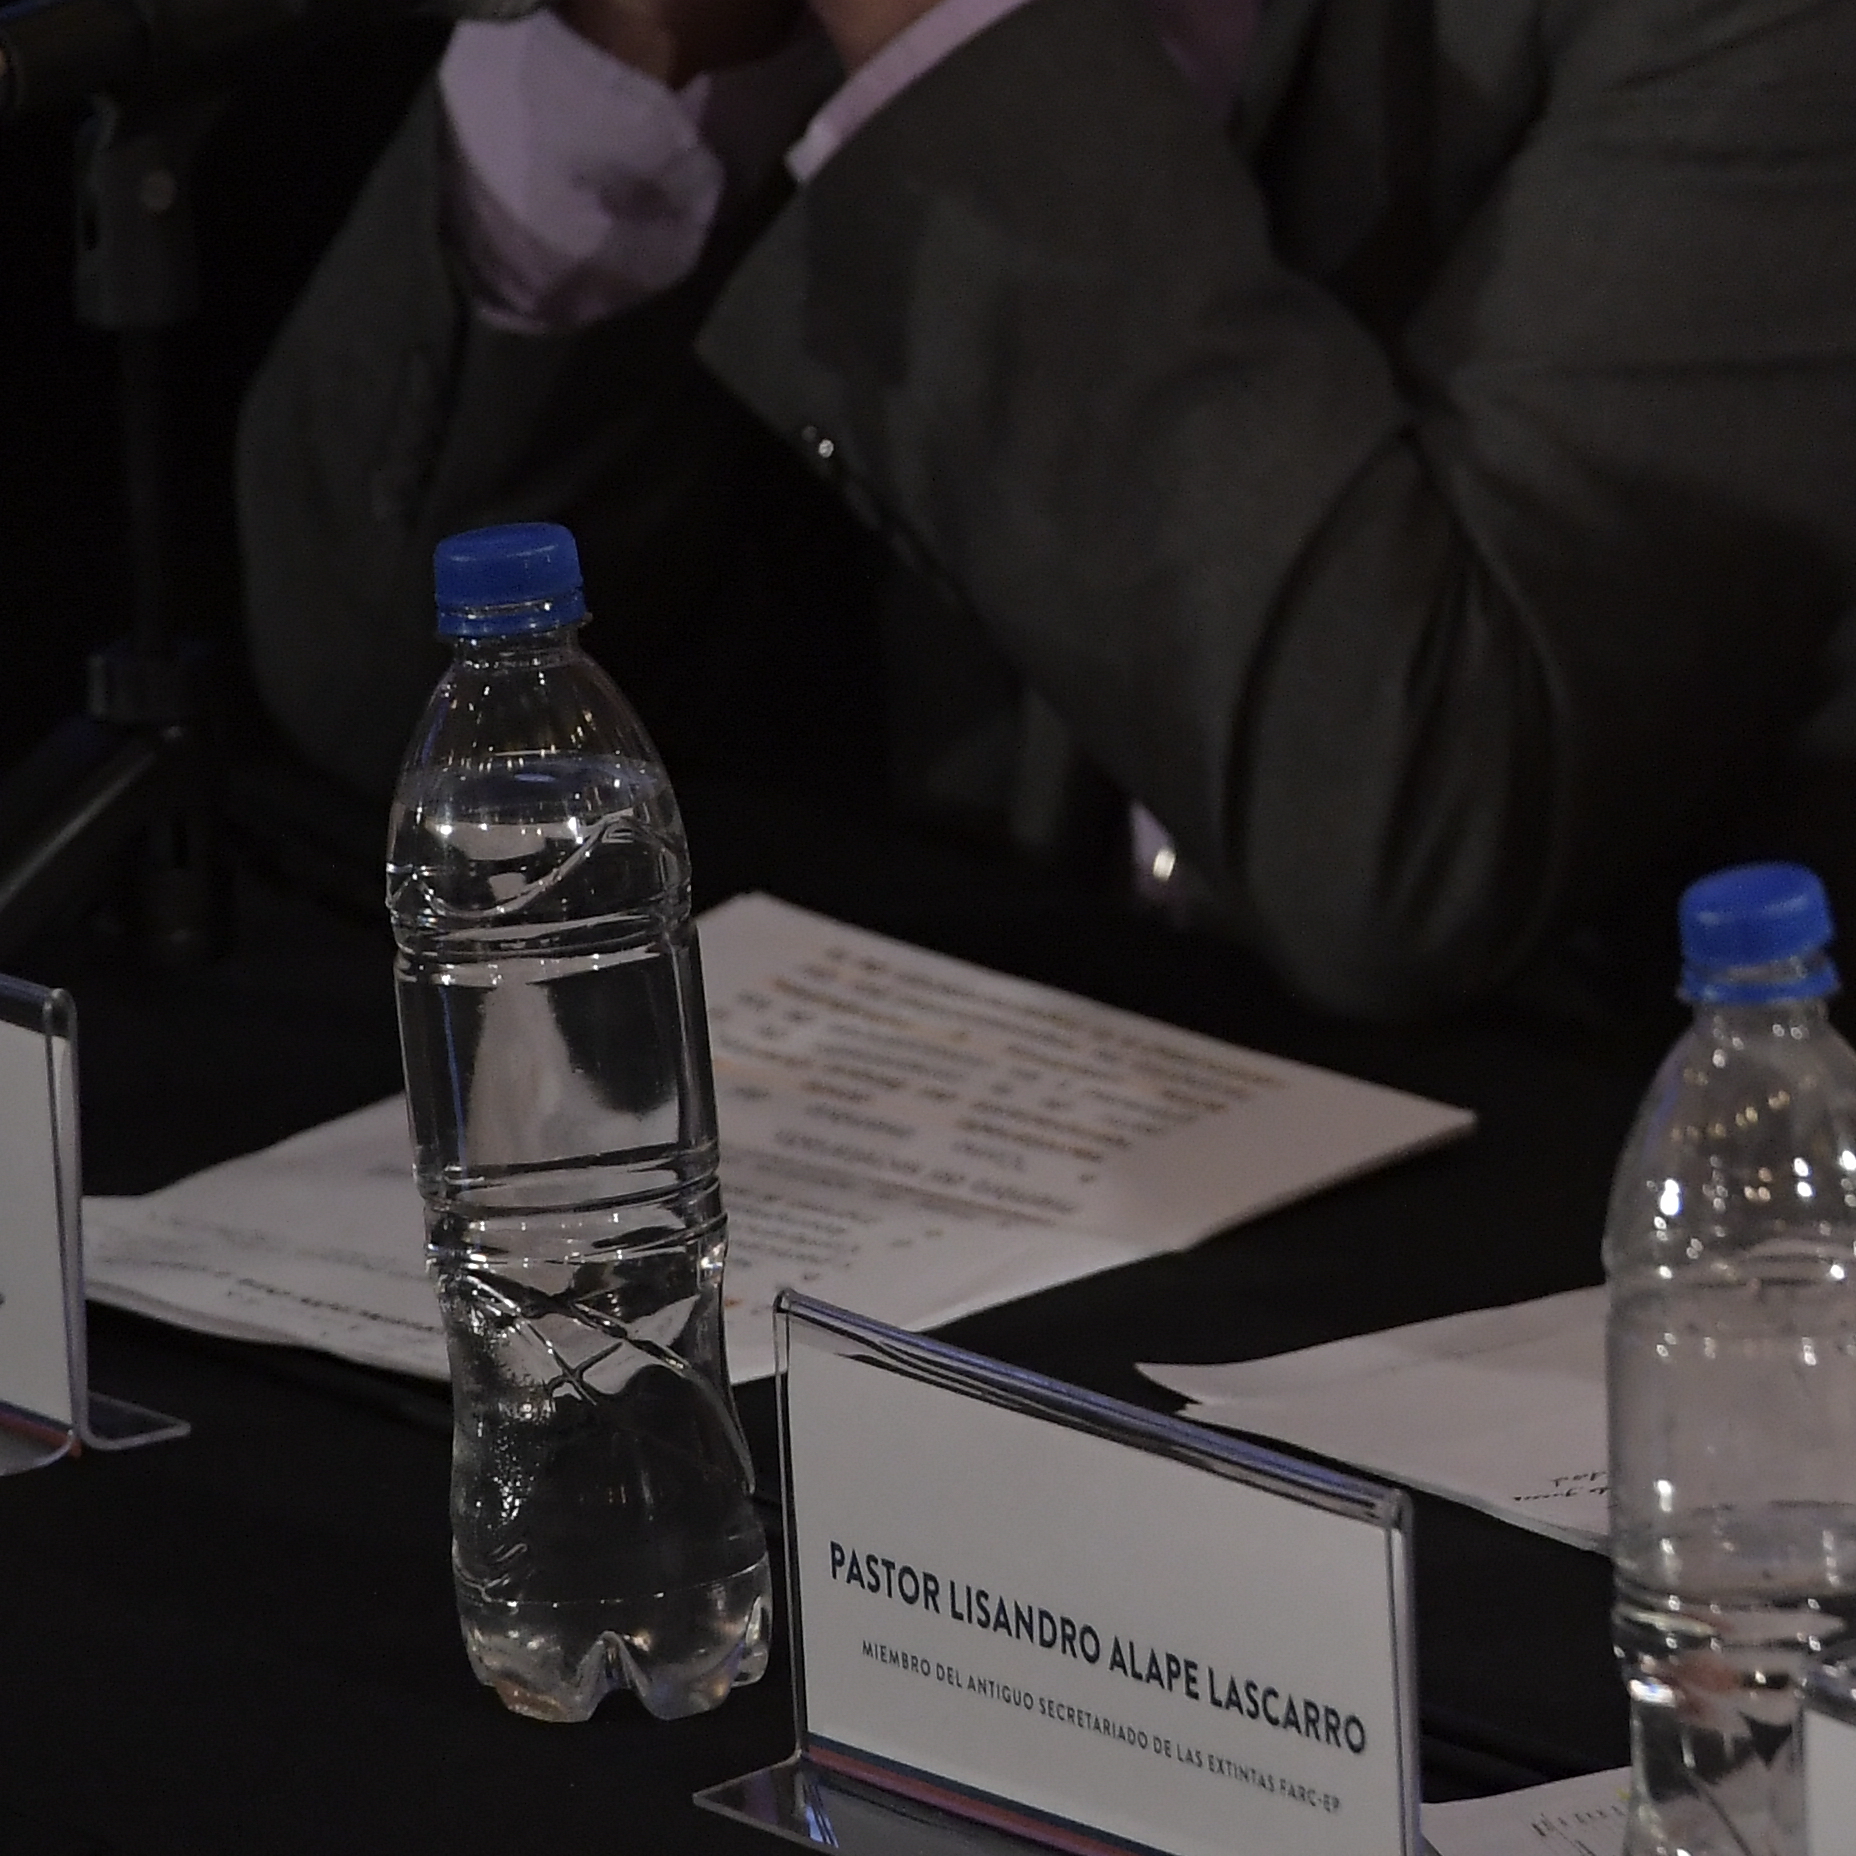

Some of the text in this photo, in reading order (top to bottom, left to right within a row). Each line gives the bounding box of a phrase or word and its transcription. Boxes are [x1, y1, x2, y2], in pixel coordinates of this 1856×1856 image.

[830, 1541, 1367, 1756] PASTOR LISANDRO ALAPE LASCARRO
[863, 1640, 1341, 1813] MIEMBRO DEL ANTIGUO SECRETARIADO DE LAS EXTINTAS FARC-EP
